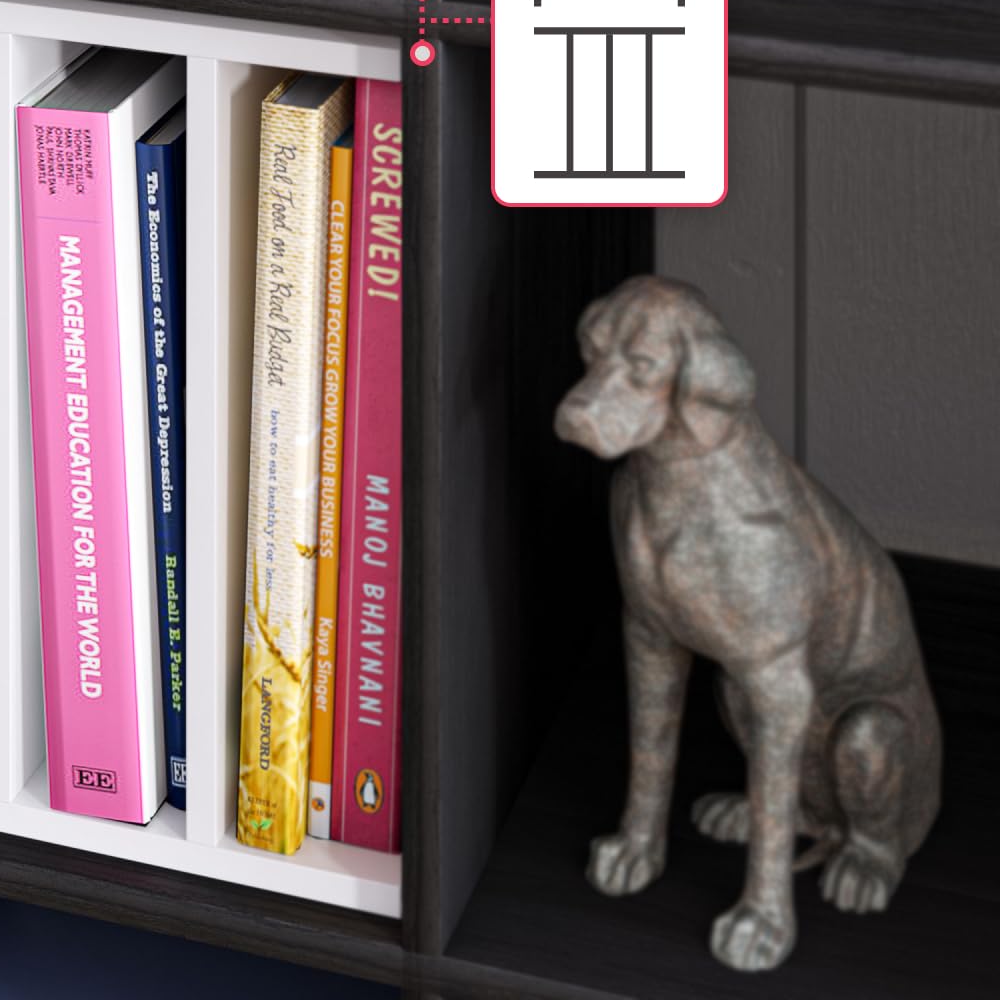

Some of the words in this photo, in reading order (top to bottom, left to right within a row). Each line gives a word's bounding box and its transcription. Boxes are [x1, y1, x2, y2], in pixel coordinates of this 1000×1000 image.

[147, 171, 159, 205] The
[272, 143, 297, 184] Real
[270, 186, 296, 231] Food
[329, 199, 345, 254] CLEAR
[366, 123, 403, 302] SCREWED!
[147, 209, 163, 303] Economics
[270, 262, 286, 277] a
[271, 236, 287, 259] on
[267, 281, 293, 321] Real
[327, 256, 344, 308] YOUR
[58, 235, 88, 389] MANAGEMENT
[153, 306, 165, 326] of
[324, 309, 342, 366] FOCUS
[154, 330, 167, 358] the
[264, 324, 292, 388] Budget
[155, 363, 169, 413] Great
[323, 368, 340, 425] GROW
[269, 441, 280, 456] to
[270, 409, 281, 438] how
[66, 392, 94, 521] EDUCATION
[157, 416, 173, 514] Depression
[268, 460, 278, 481] eat
[322, 425, 338, 475] YOUR
[263, 485, 279, 538] healthy
[319, 476, 336, 559] BUSINESS
[361, 473, 390, 568] MANOJ
[71, 525, 95, 569] FOR
[266, 541, 277, 562] for
[75, 572, 98, 614] THE
[165, 554, 180, 622] Randall
[77, 616, 102, 700] WORLD
[168, 627, 181, 647] E.
[315, 615, 334, 657] Kaya
[357, 582, 386, 727] BHAVNANI
[168, 650, 182, 713] Parker
[315, 659, 333, 713] Singer
[259, 675, 273, 771] LANGFORD
[76, 768, 114, 790] EE
